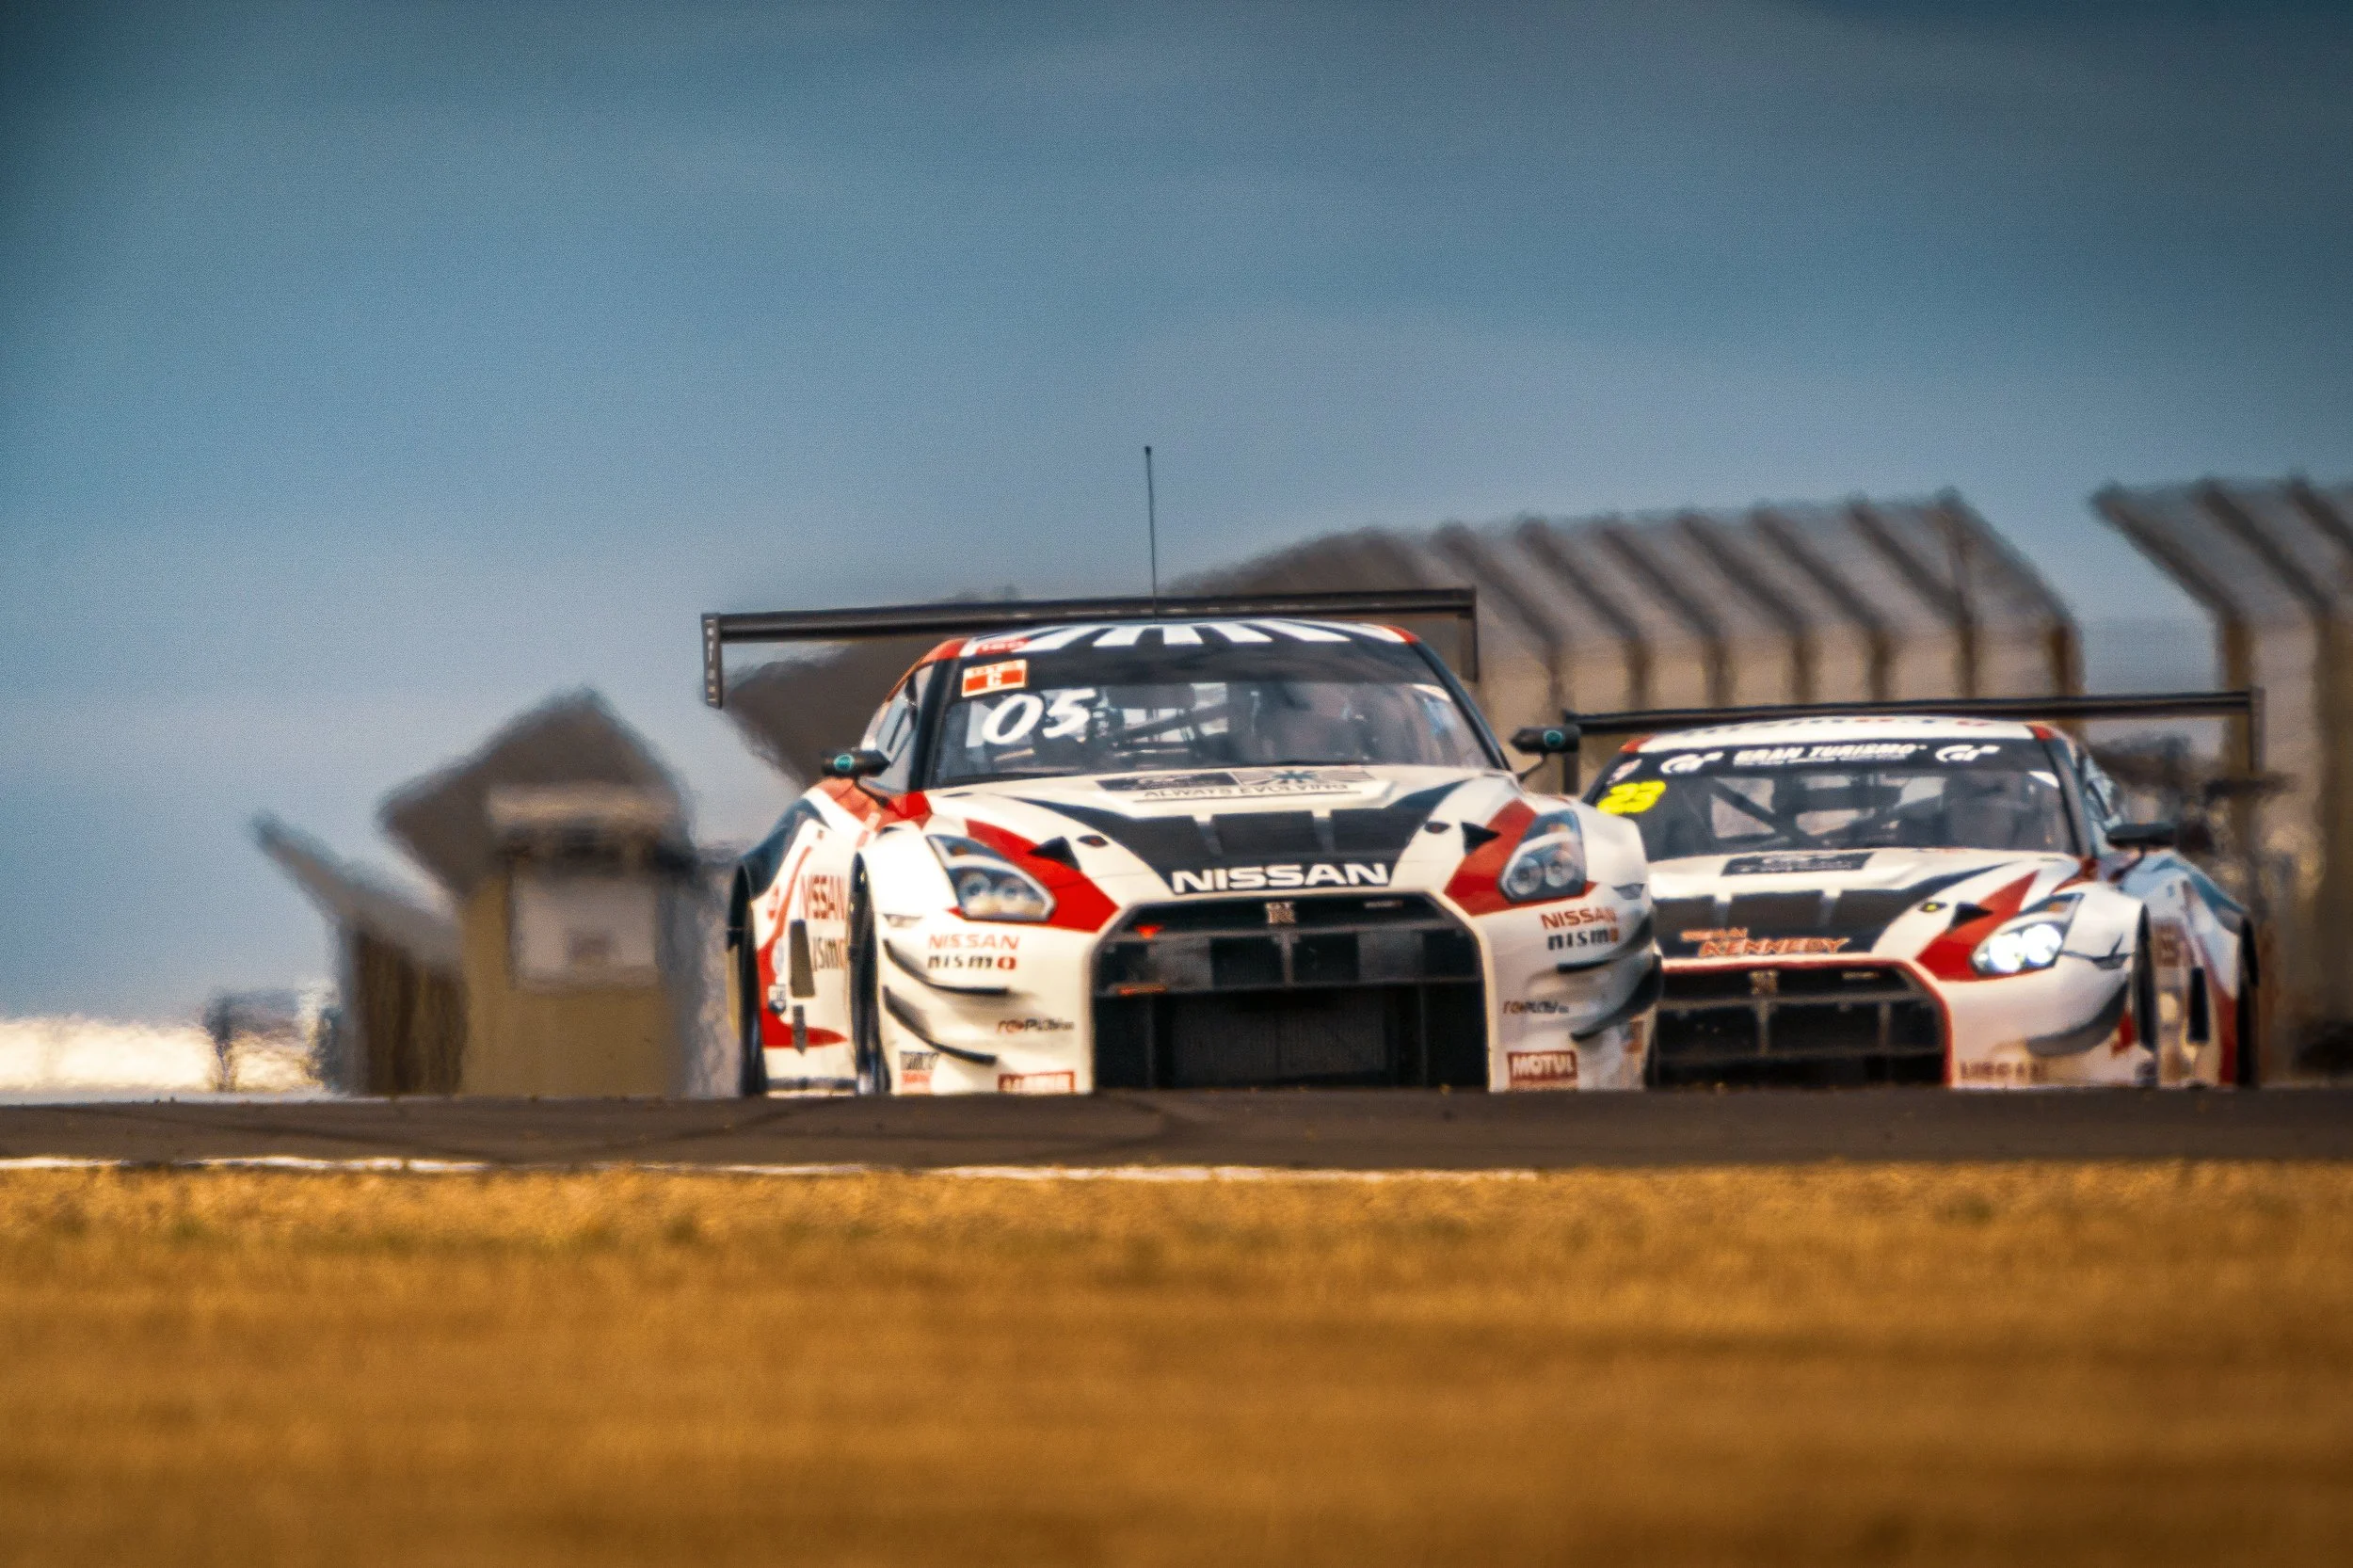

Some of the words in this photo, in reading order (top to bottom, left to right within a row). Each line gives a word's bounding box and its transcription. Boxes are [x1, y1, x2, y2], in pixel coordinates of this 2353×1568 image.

[982, 687, 1096, 744] 05
[1733, 748, 1805, 762] GRAN
[1808, 744, 1916, 759] TURISMO
[1144, 787, 1233, 798] ALWAYS
[1597, 780, 1667, 814] 23
[1172, 862, 1389, 893] NISSAN
[1540, 906, 1618, 930] NISSAN
[928, 933, 1020, 951] NISSAN
[1512, 1052, 1576, 1076] MOTUL
